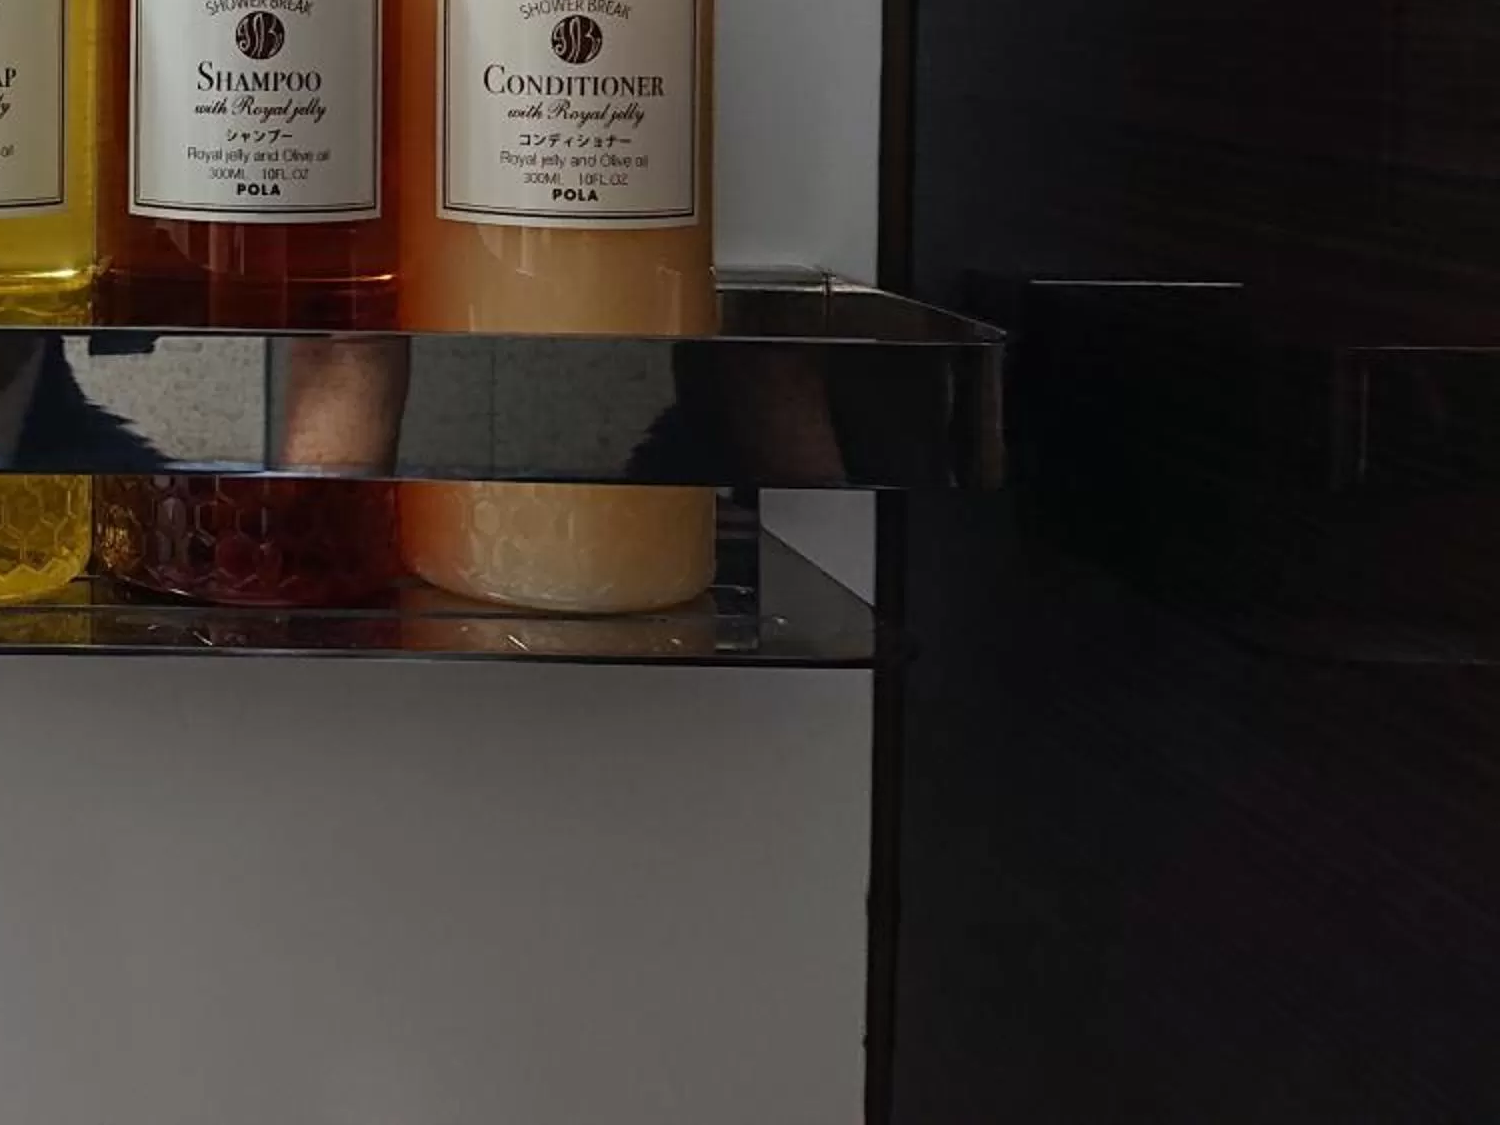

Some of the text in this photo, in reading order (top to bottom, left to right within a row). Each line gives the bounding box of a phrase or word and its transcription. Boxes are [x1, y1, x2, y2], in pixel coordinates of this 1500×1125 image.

[197, 60, 323, 92] SHAMPOO
[483, 64, 666, 97] CONDITIONER
[195, 95, 326, 123] with Royal jelly
[508, 99, 645, 128] with Royal jelly
[518, 133, 633, 148] コンディショナー
[187, 146, 223, 163] Royal
[225, 148, 251, 163] jelly
[254, 148, 279, 162] and
[283, 147, 314, 162] Olive
[500, 150, 537, 168] Royal
[541, 153, 565, 169] jelly
[570, 154, 597, 168] and
[600, 153, 631, 168] Olive
[237, 183, 281, 196] POLA
[552, 188, 599, 201] POLA
